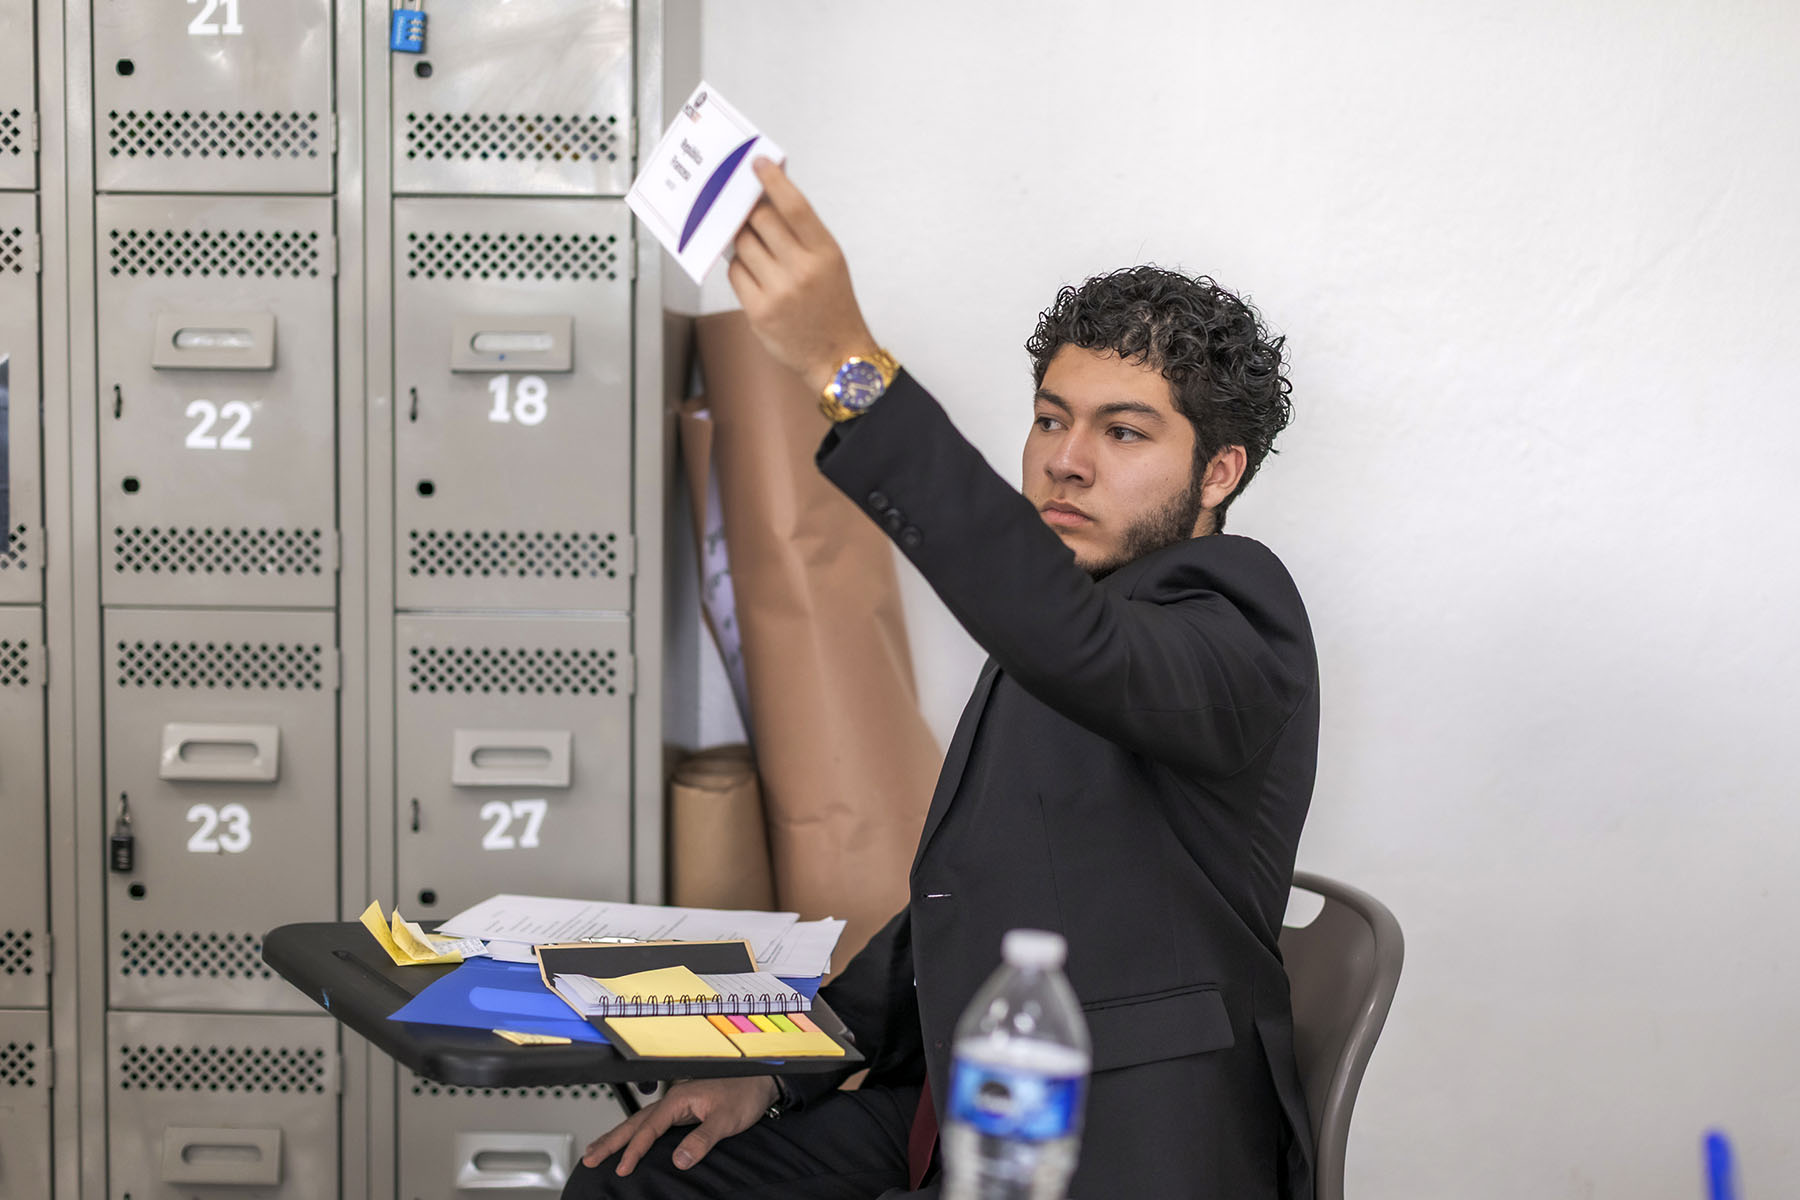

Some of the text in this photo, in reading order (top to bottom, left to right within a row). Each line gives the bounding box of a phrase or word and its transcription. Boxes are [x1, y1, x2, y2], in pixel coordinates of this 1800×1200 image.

[188, 0, 243, 35] 21
[186, 400, 252, 449] 22
[488, 376, 548, 426] 18
[187, 804, 252, 853] 23
[481, 800, 547, 850] 27
